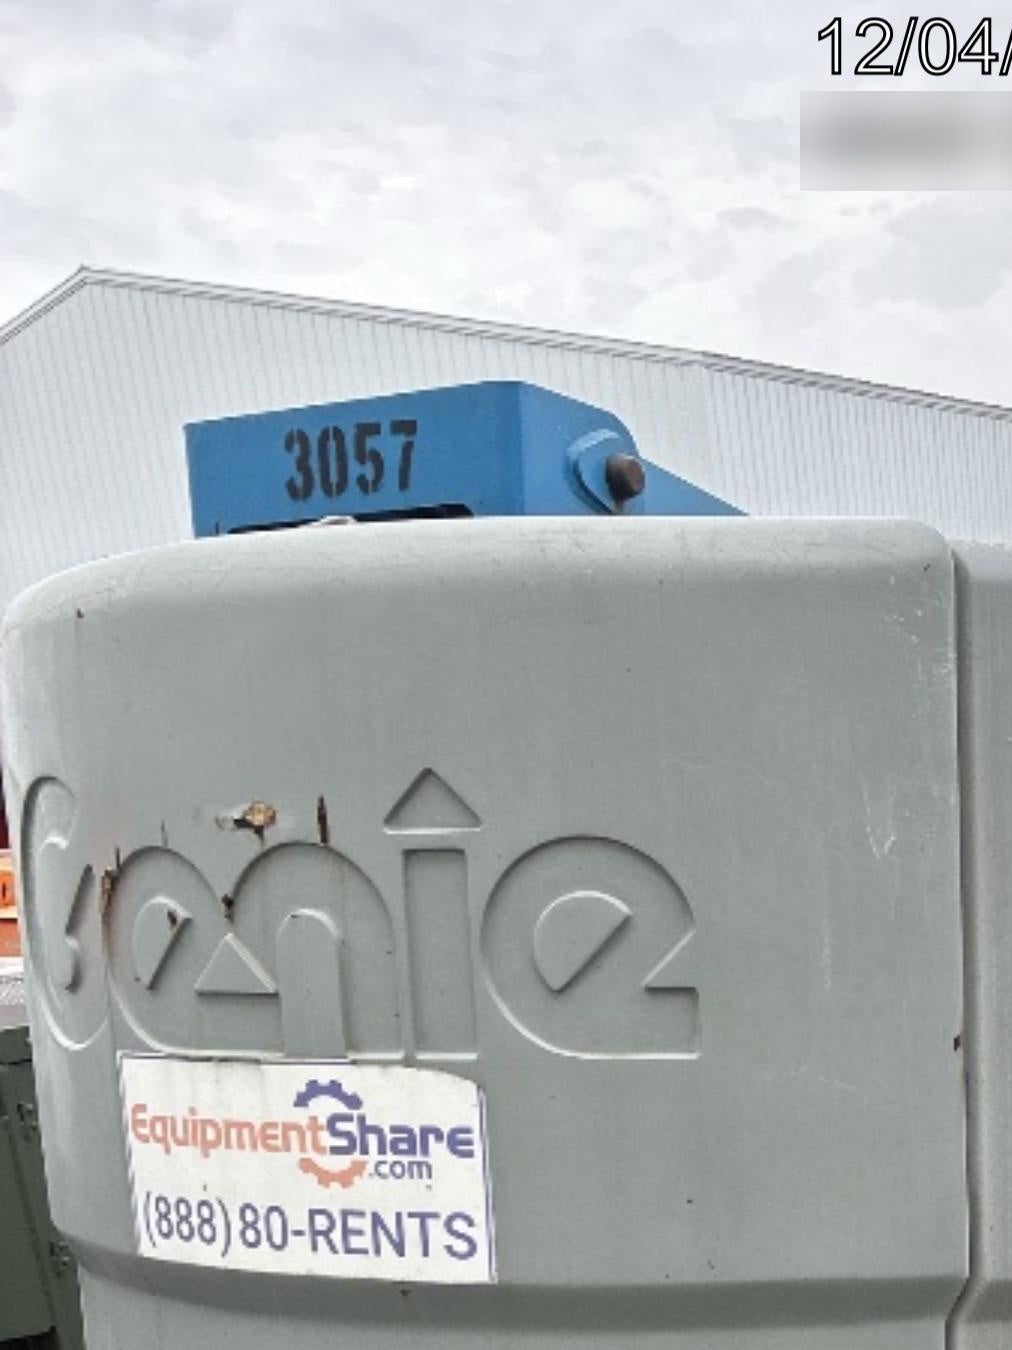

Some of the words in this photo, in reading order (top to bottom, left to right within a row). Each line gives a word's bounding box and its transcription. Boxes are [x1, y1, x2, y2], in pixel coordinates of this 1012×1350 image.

[284, 419, 418, 501] 3057
[21, 768, 700, 1059] Genie
[131, 1103, 475, 1159] EquipmentShare
[368, 1158, 432, 1180] .com
